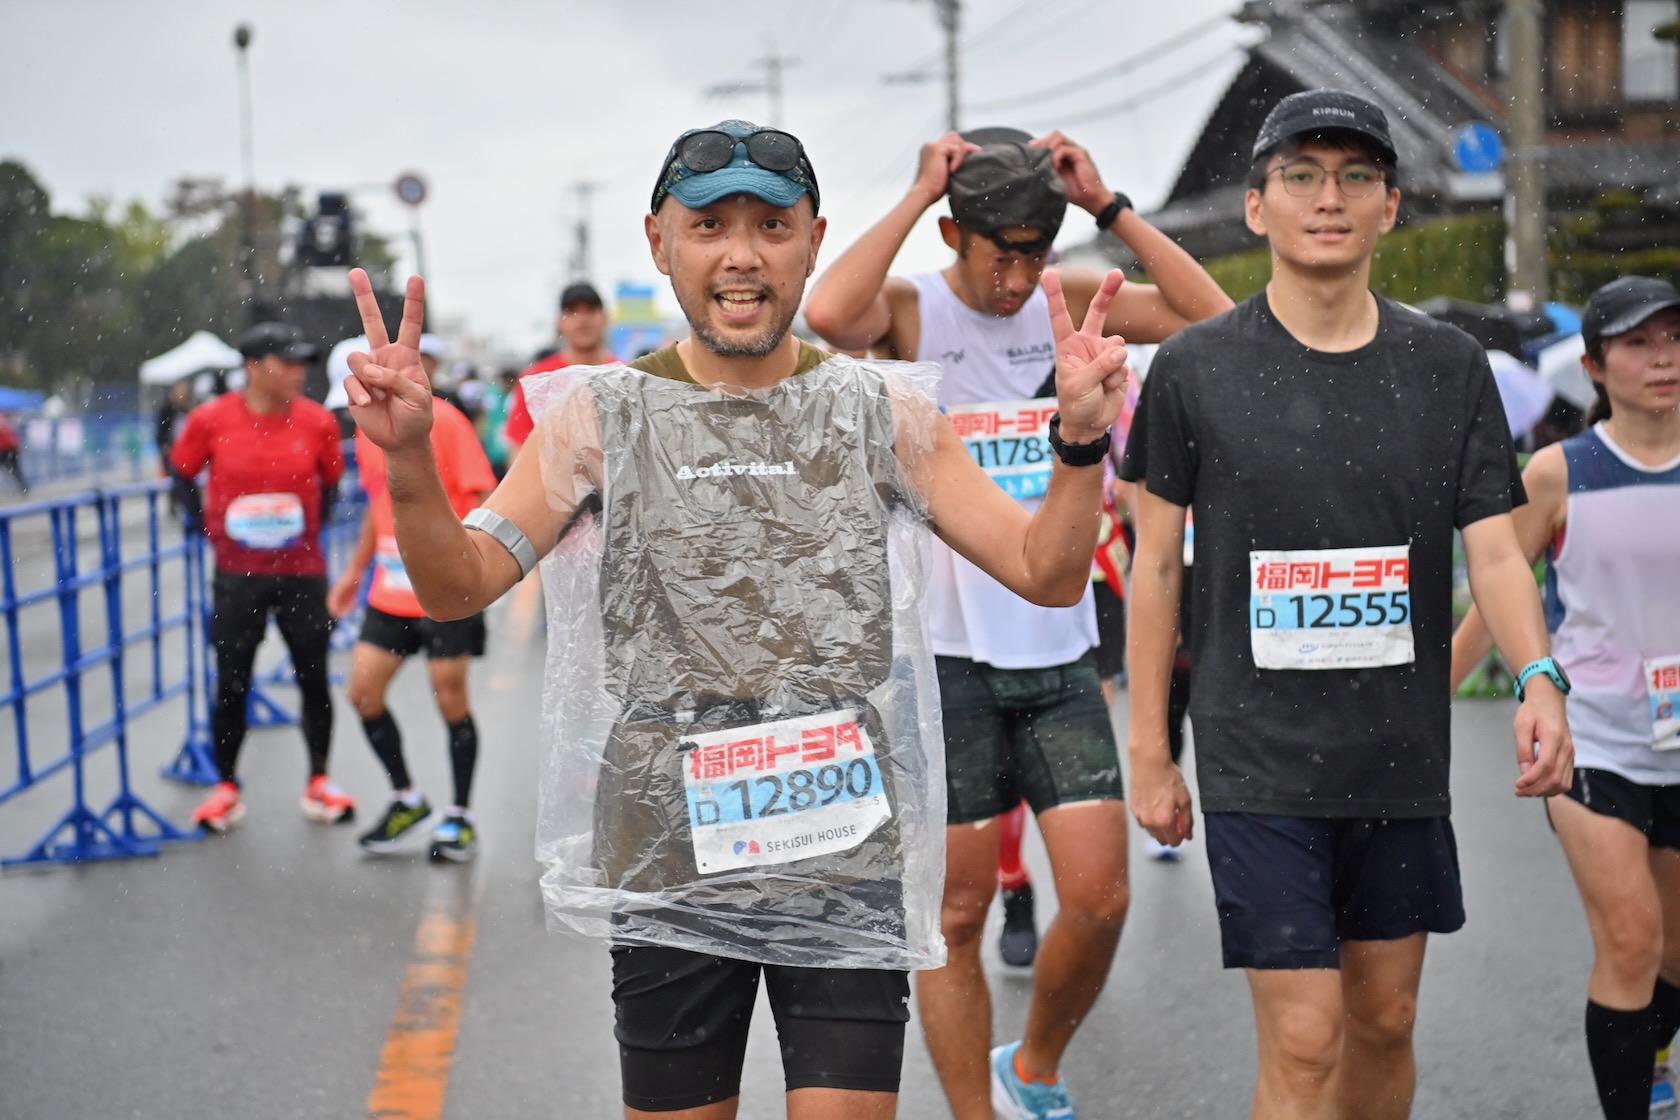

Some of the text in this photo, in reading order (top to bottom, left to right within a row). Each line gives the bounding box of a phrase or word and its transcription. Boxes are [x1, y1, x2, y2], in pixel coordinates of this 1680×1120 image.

[1312, 107, 1356, 119] KIPRUN
[970, 437, 1052, 467] 1178
[676, 460, 797, 480] Activital
[1256, 558, 1409, 590] 福岡トヨタ
[1256, 590, 1409, 629] D 12555
[1657, 703, 1673, 721] C
[689, 721, 864, 780] 福岡トヨタ
[695, 757, 872, 826] D 12890
[766, 824, 857, 853] SEKISUI HOUSE
